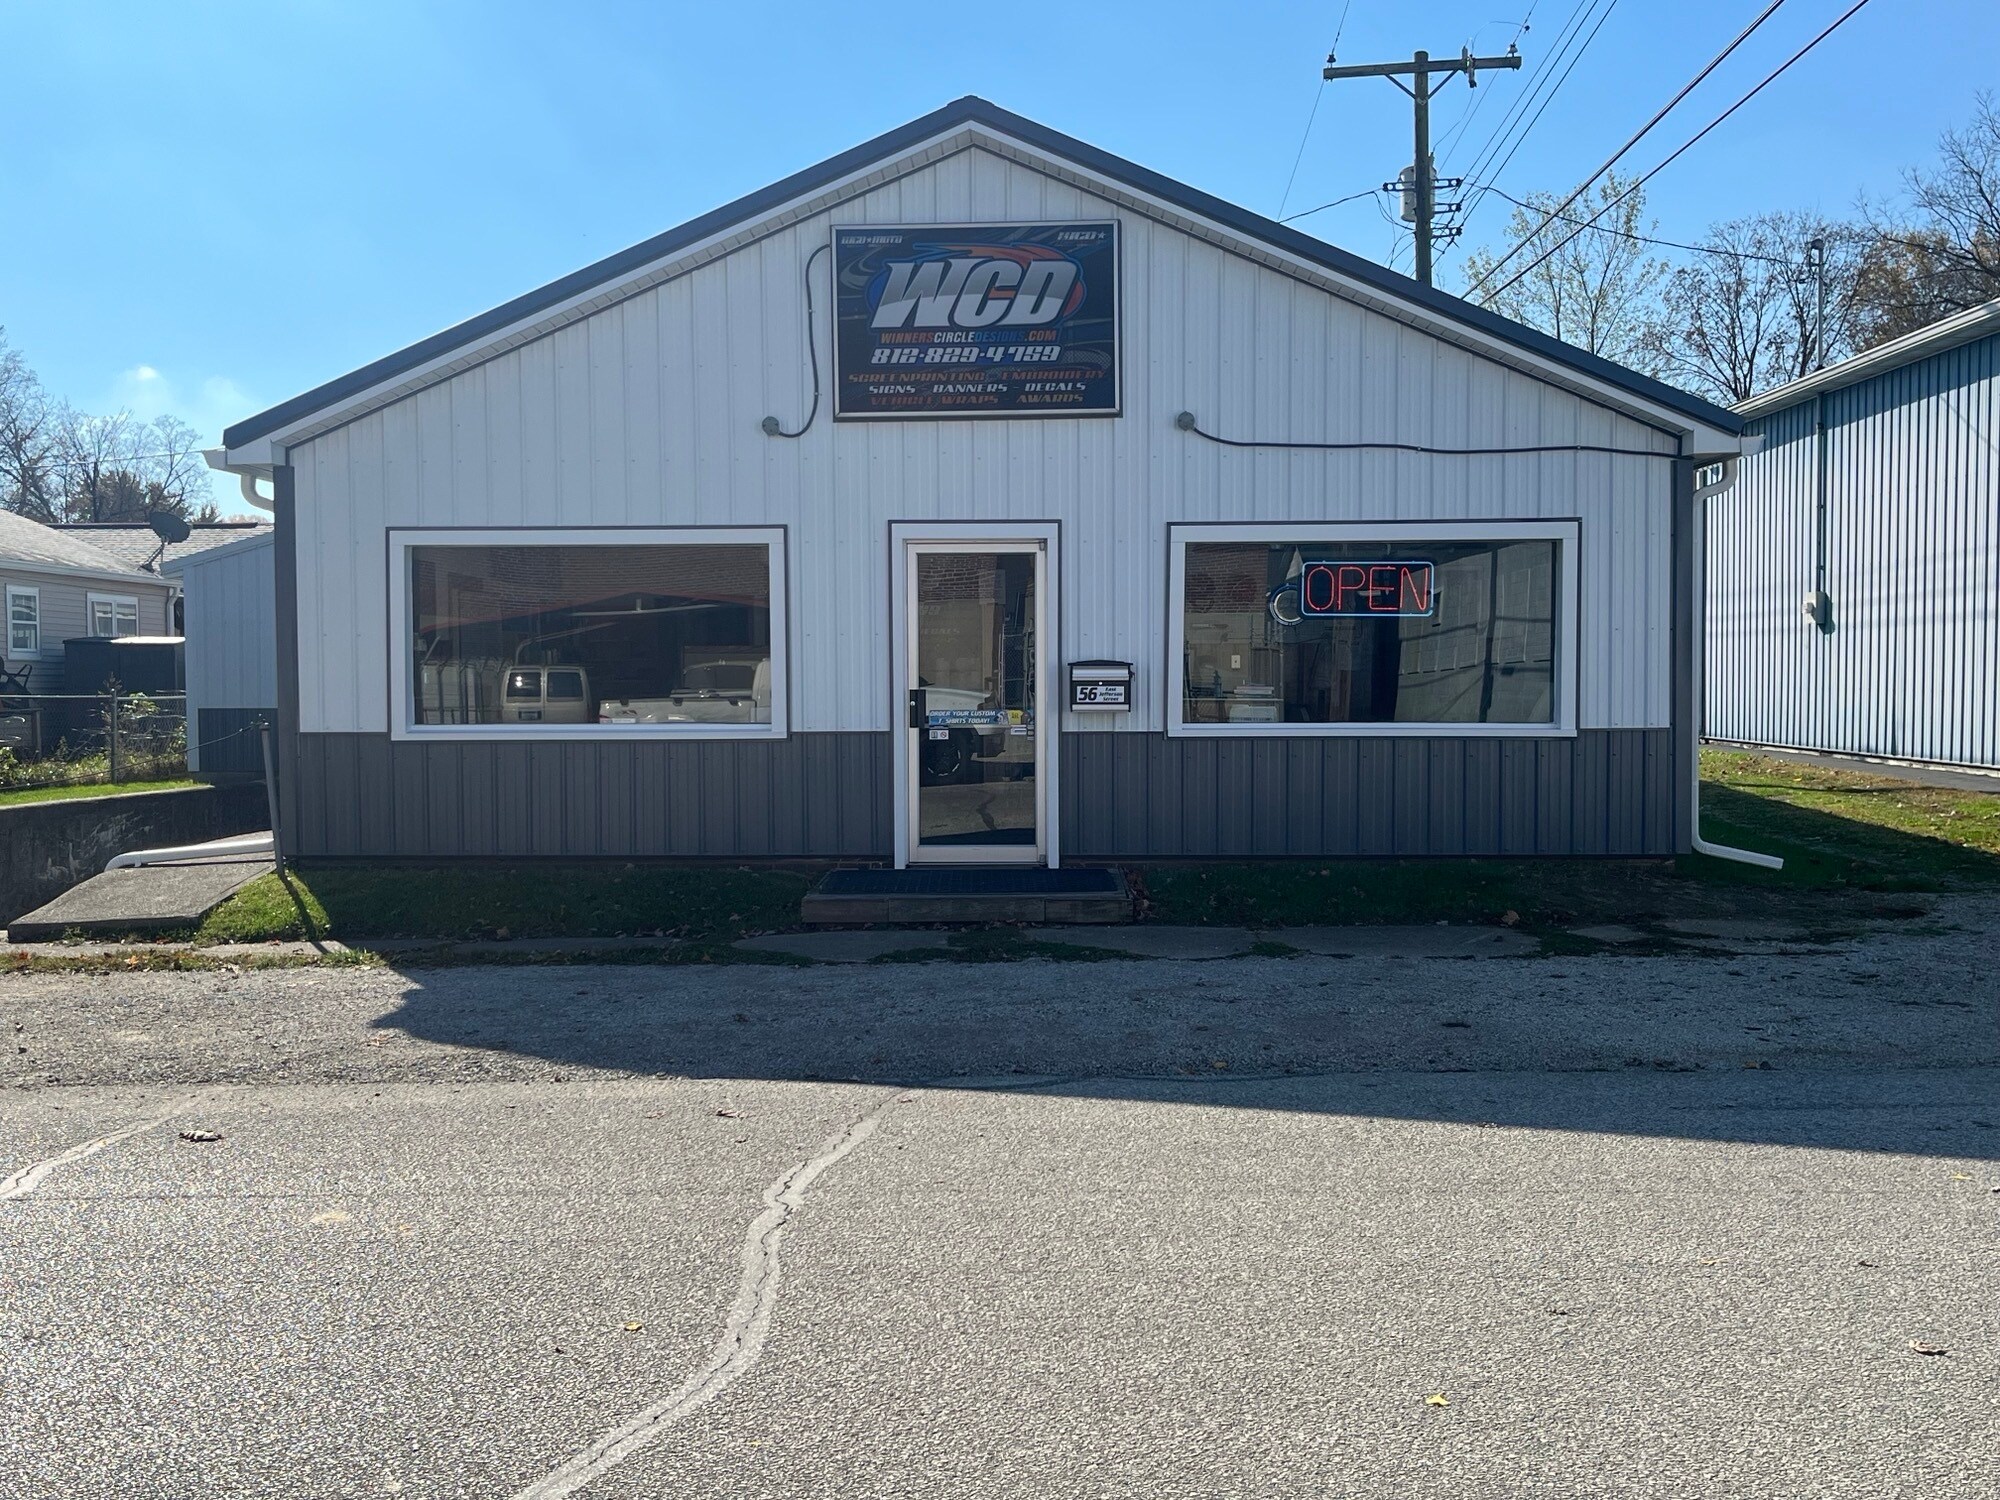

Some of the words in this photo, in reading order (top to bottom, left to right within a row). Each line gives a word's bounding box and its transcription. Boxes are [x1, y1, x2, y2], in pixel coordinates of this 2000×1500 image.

[870, 258, 1078, 328] WCD
[868, 385, 916, 394] SIGNS
[933, 383, 1008, 394] BANNERS
[1024, 382, 1087, 392] DECALS
[940, 395, 999, 405] WRAPS
[1016, 394, 1083, 404] AWARDS
[1306, 565, 1430, 612] OPEN
[1078, 687, 1098, 701] 56
